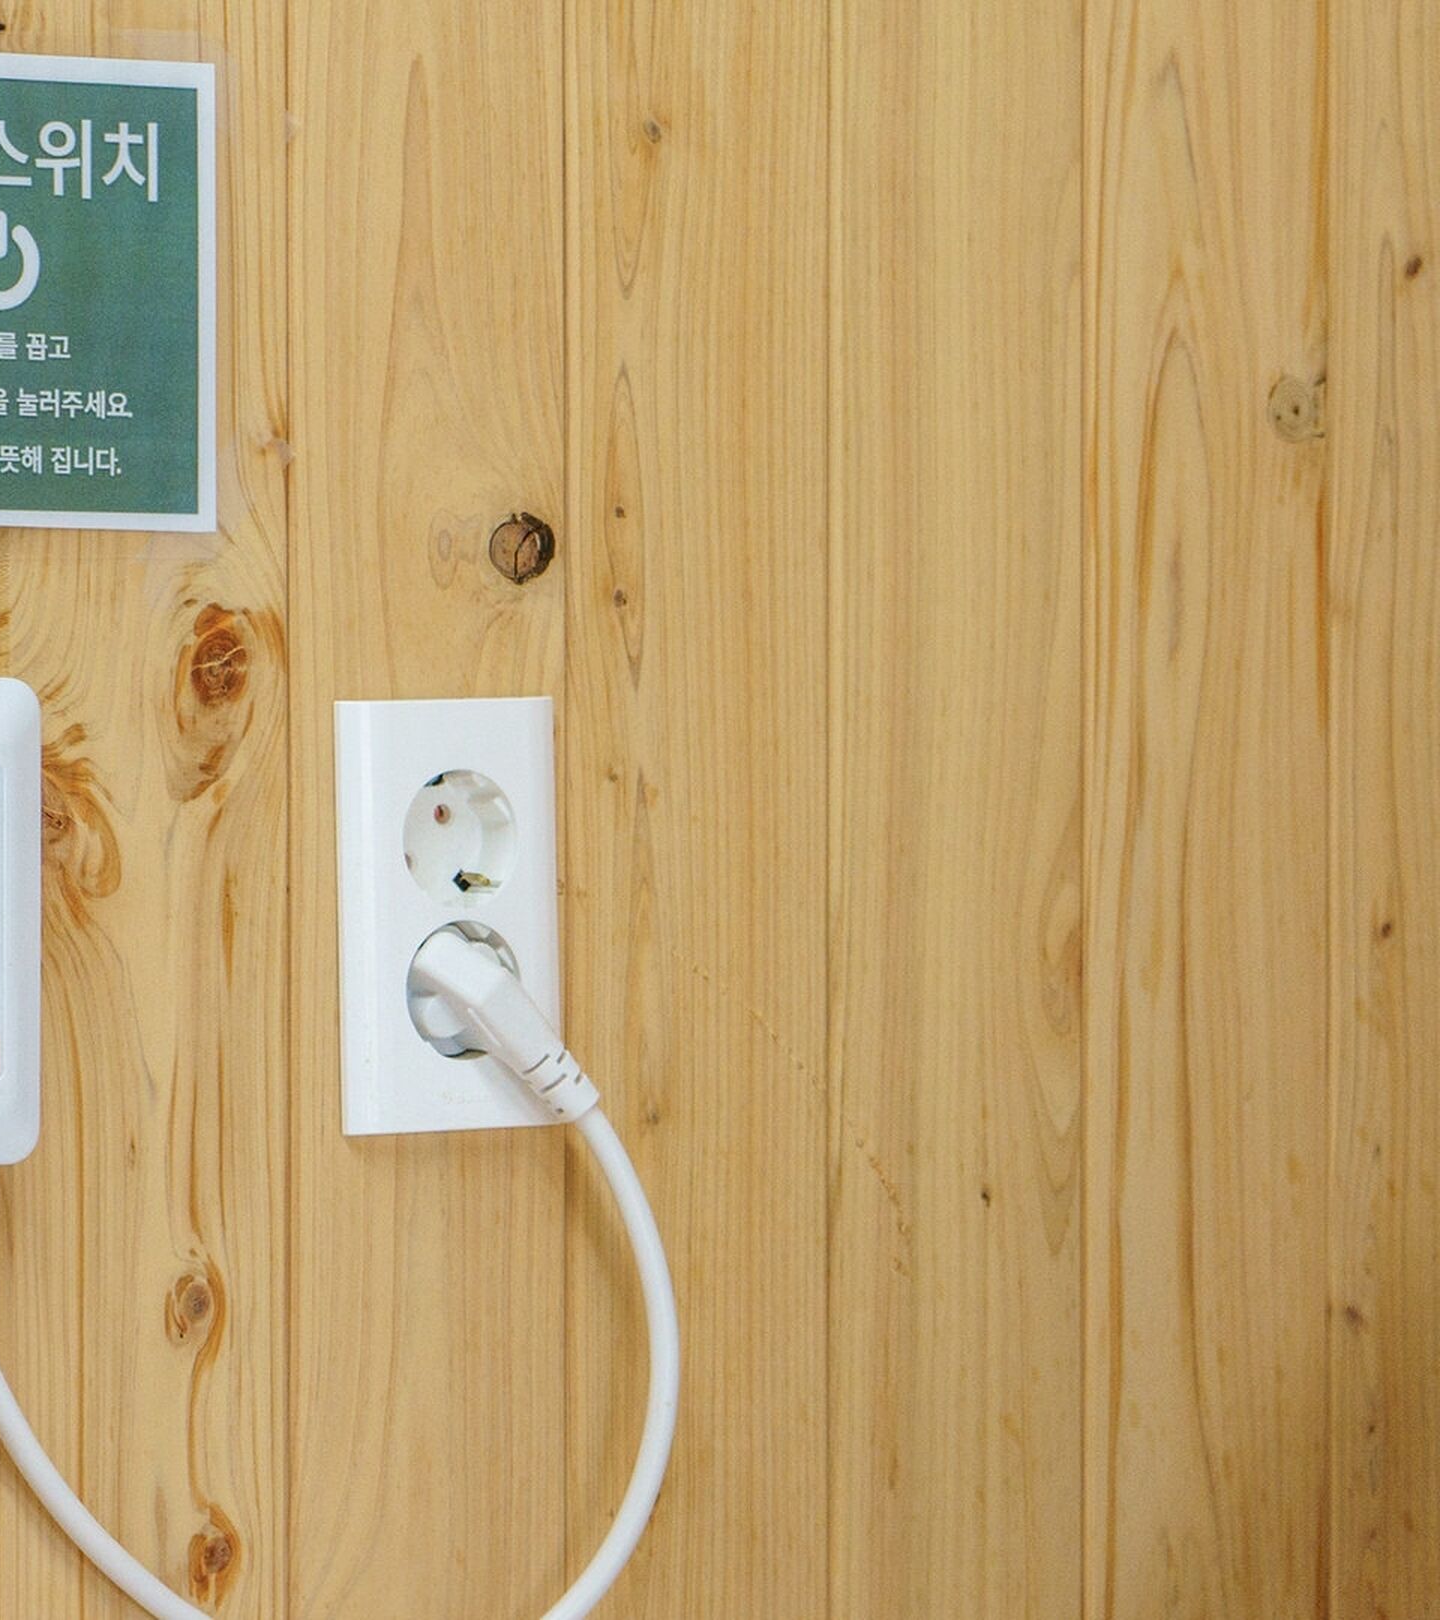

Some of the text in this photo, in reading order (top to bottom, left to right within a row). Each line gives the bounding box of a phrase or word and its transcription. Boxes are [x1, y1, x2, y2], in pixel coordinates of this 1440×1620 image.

[25, 333, 72, 361] 꼽고
[16, 388, 133, 420] 눌러주세요.
[51, 446, 122, 477] 집니다.
